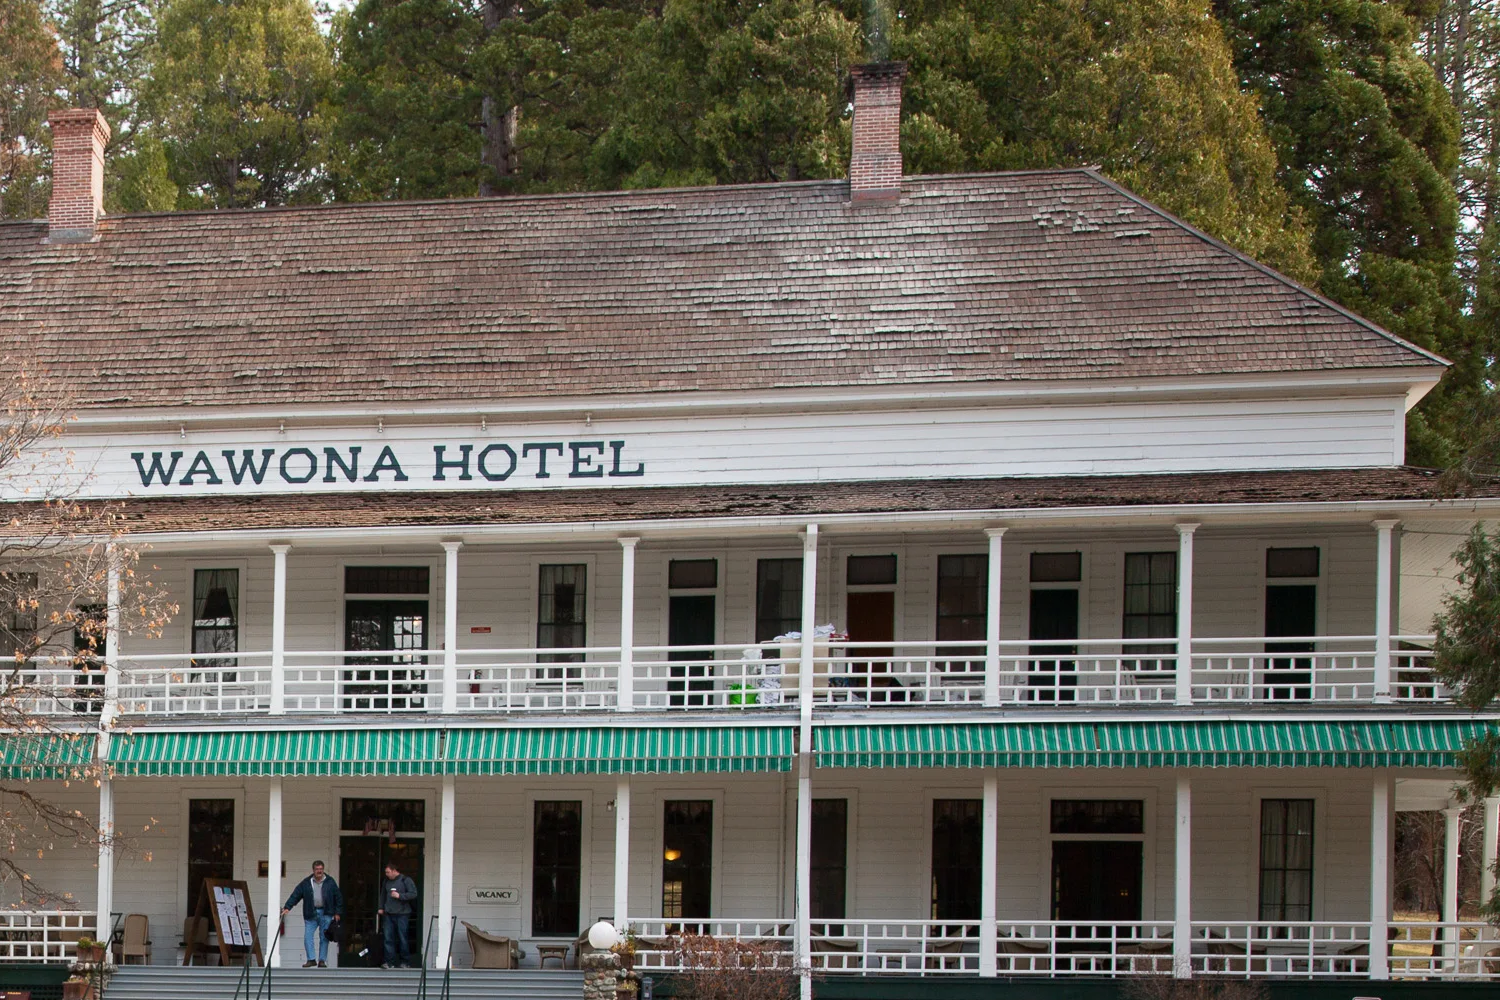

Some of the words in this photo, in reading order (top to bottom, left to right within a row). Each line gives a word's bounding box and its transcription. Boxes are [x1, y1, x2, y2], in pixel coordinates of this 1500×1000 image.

[131, 445, 409, 487] WAWONA
[432, 440, 645, 481] HOTEL
[476, 891, 512, 899] VACANCY
